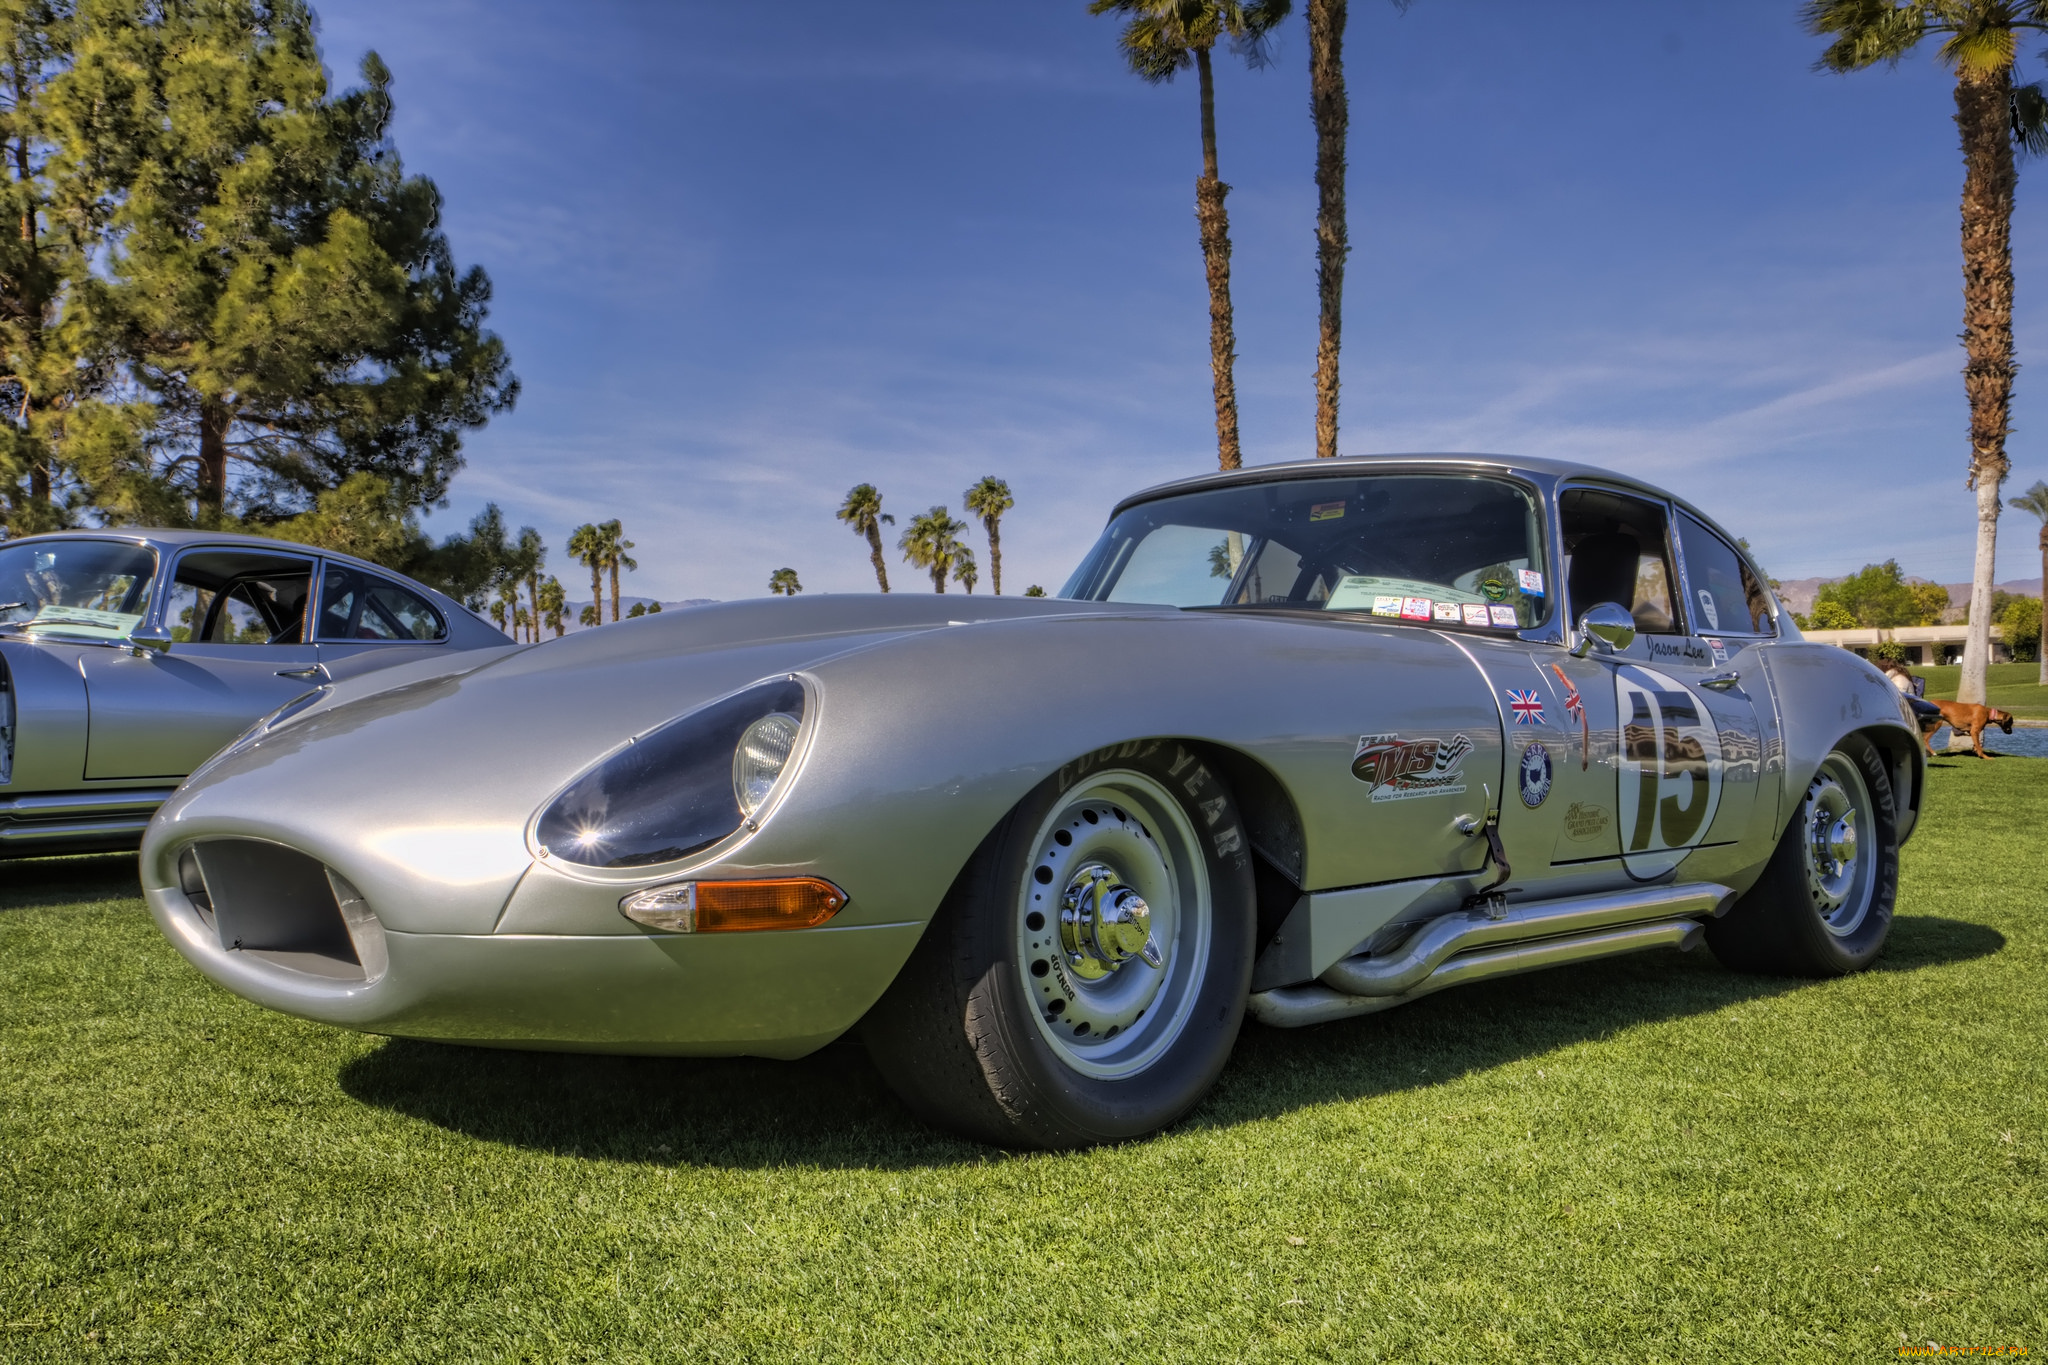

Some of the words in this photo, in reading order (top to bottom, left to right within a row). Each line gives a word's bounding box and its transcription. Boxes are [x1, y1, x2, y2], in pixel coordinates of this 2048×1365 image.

[1646, 635, 1680, 661] Jason
[1683, 638, 1706, 660] Len
[1361, 735, 1397, 746] TEAM
[1522, 744, 1548, 768] USRRC
[1392, 775, 1458, 792] RACING
[1624, 691, 1709, 851] 15
[1050, 954, 1076, 1002] DUNLOP
